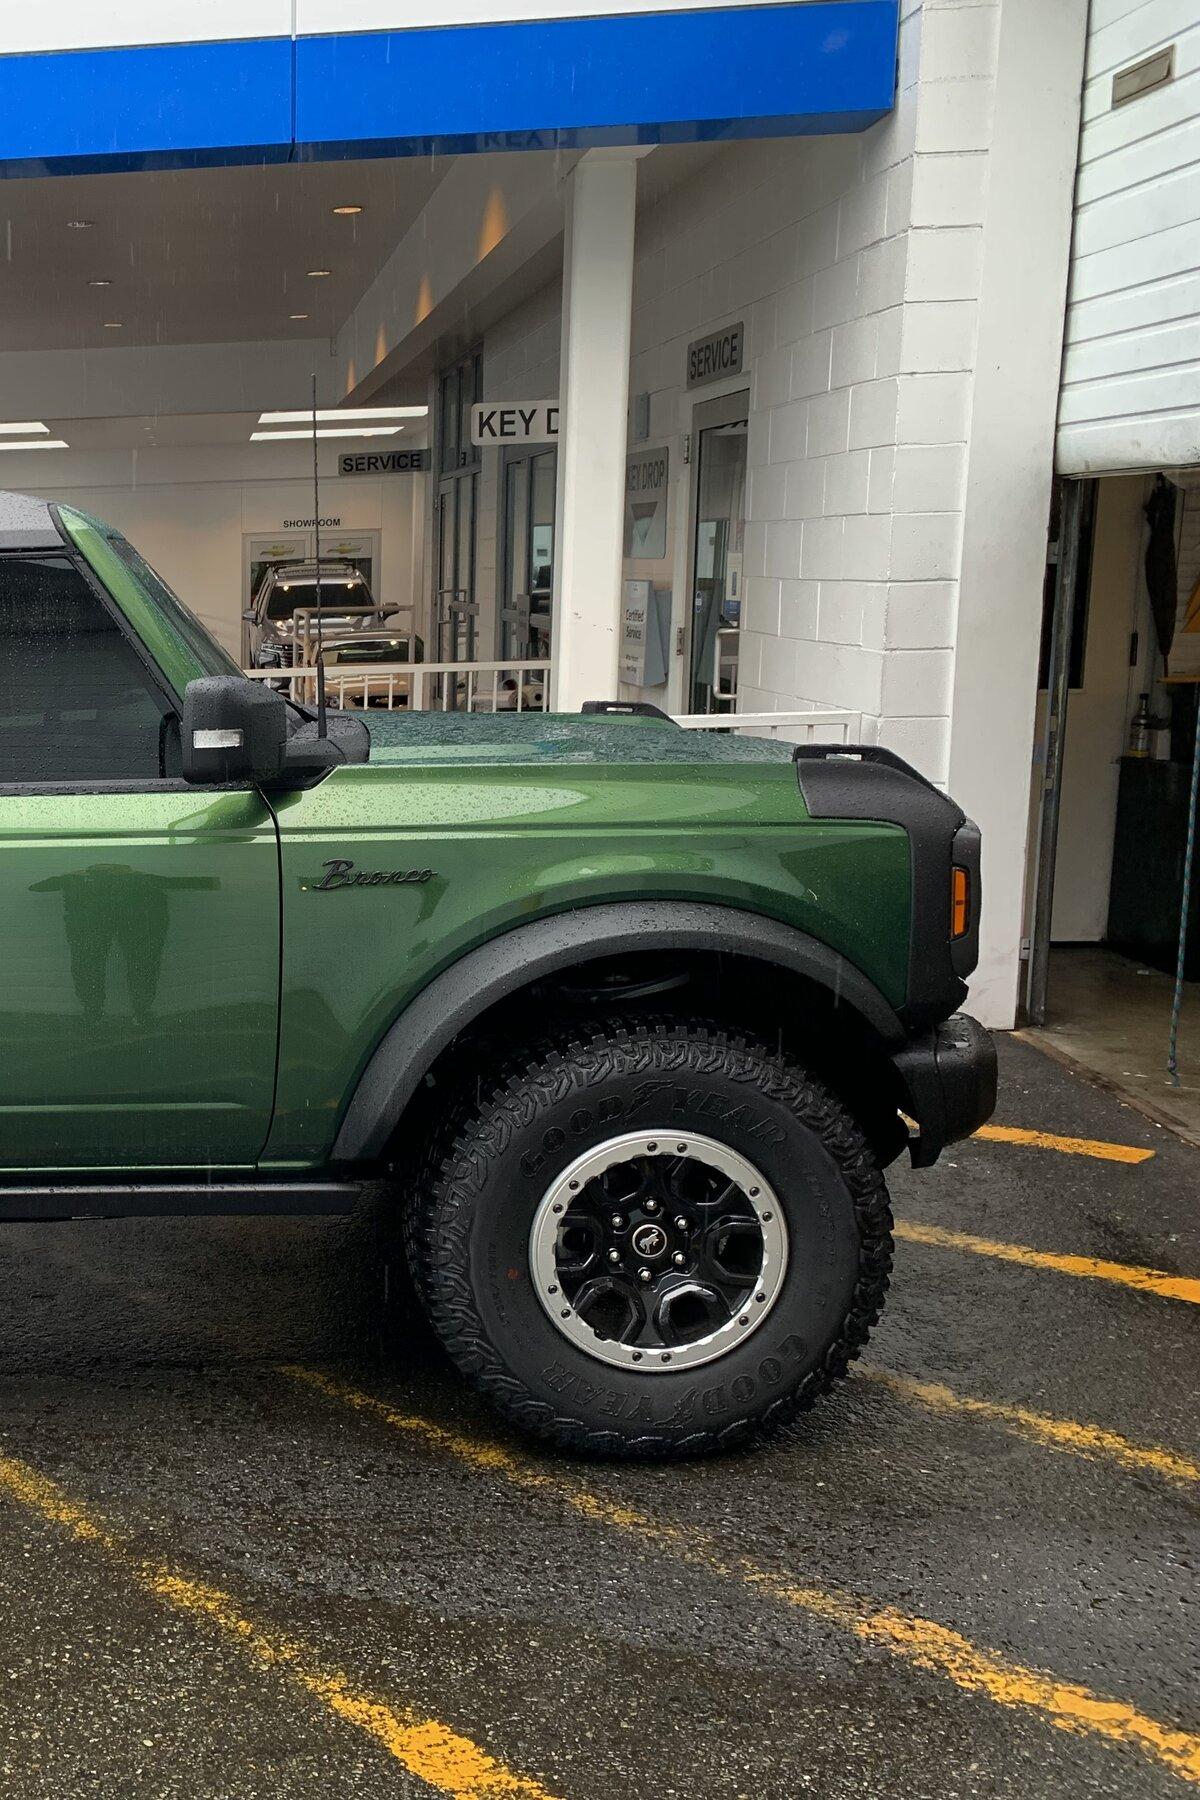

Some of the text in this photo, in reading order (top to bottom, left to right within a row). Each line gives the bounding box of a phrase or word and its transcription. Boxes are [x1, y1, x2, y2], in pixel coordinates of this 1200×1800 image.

[689, 332, 739, 380] SERVICE
[478, 408, 538, 438] KEY
[342, 452, 422, 473] SERVICE
[642, 459, 665, 490] DROP
[625, 625, 642, 640] Service
[312, 858, 439, 890] Bronco
